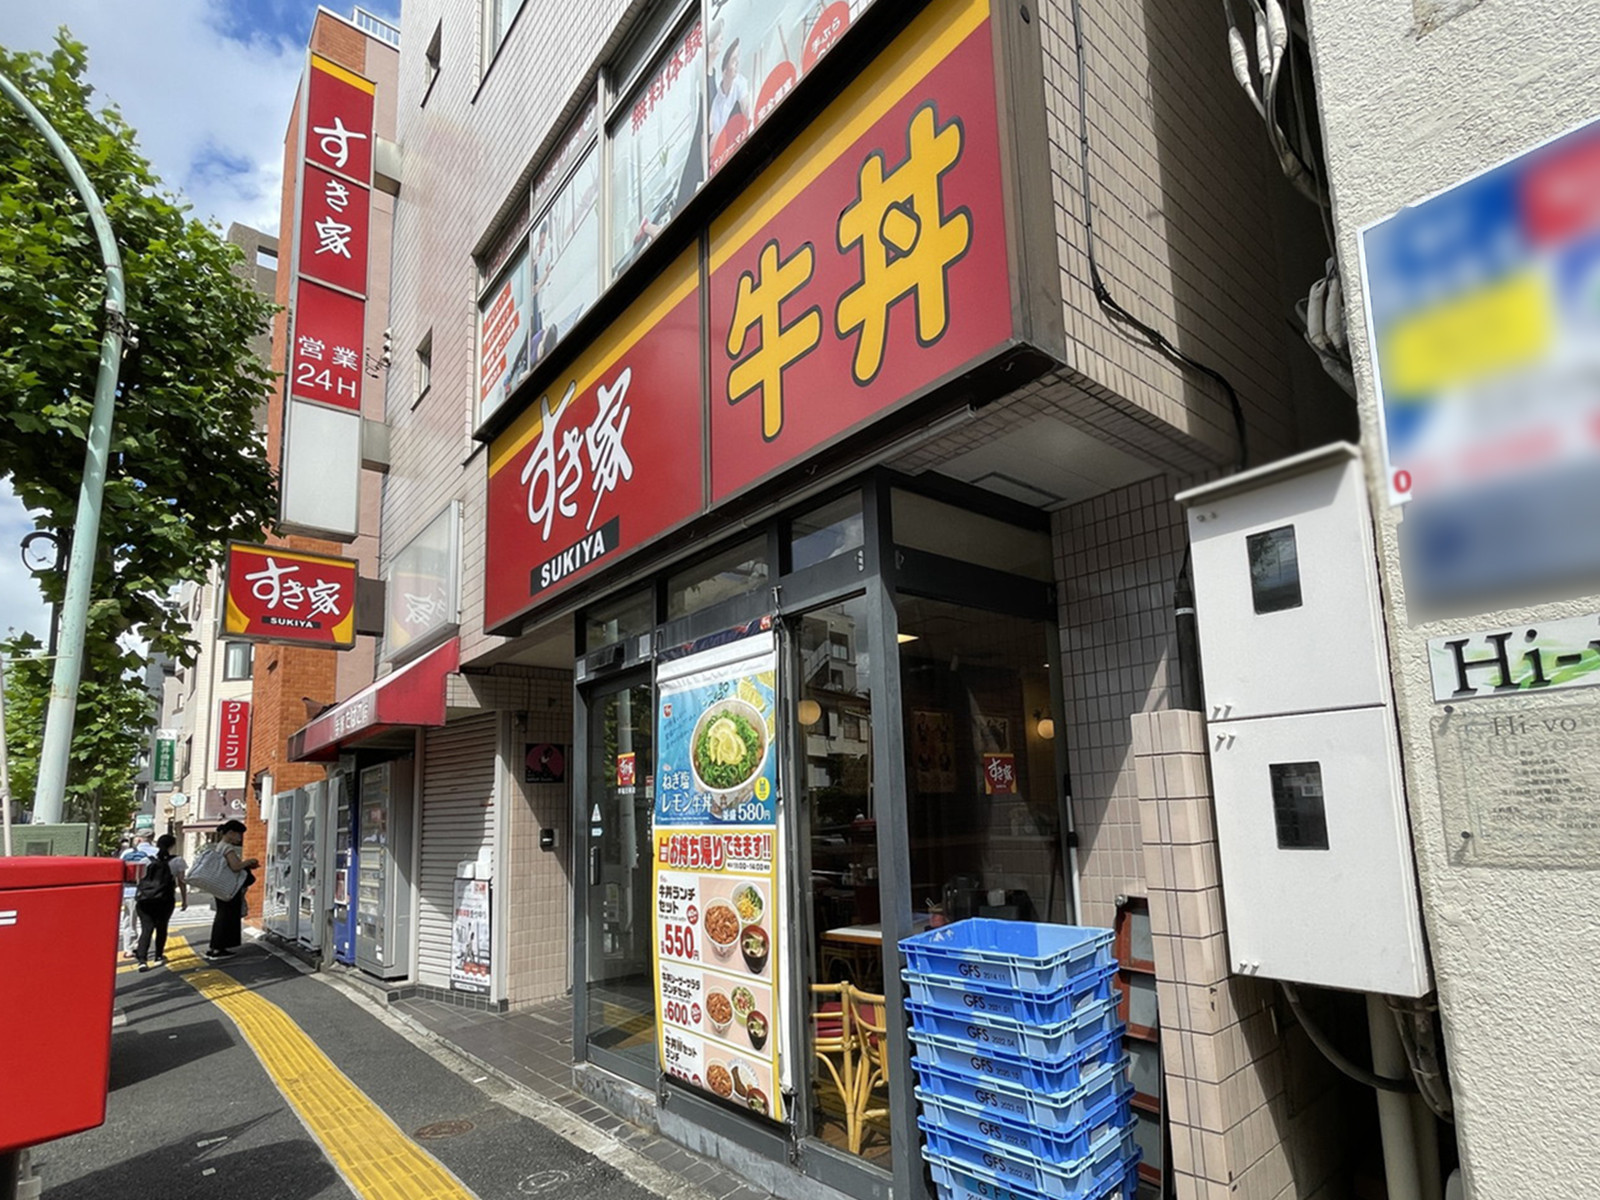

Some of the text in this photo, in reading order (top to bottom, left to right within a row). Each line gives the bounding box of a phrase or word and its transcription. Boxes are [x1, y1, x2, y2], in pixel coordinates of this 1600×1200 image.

[632, 20, 702, 136] 無料体験
[312, 116, 367, 260] すき家
[726, 99, 974, 443] 牛丼
[297, 335, 359, 373] 営業
[296, 362, 357, 398] 24H
[520, 367, 634, 541] すき家
[540, 530, 606, 588] SUKIYA
[245, 557, 341, 618] すき家
[270, 616, 314, 629] SUKIYA
[226, 702, 241, 768] クリーニング
[661, 791, 712, 813] レモン牛丼
[659, 884, 696, 901] 牛丼ランチ
[658, 900, 679, 914] セット
[959, 963, 981, 978] GFS
[963, 994, 985, 1009] GFS
[967, 1026, 989, 1042] GFS
[970, 1057, 993, 1073] GFS
[975, 1090, 998, 1107] GFS
[979, 1122, 1001, 1139] GFS
[983, 1153, 1006, 1172] GFS
